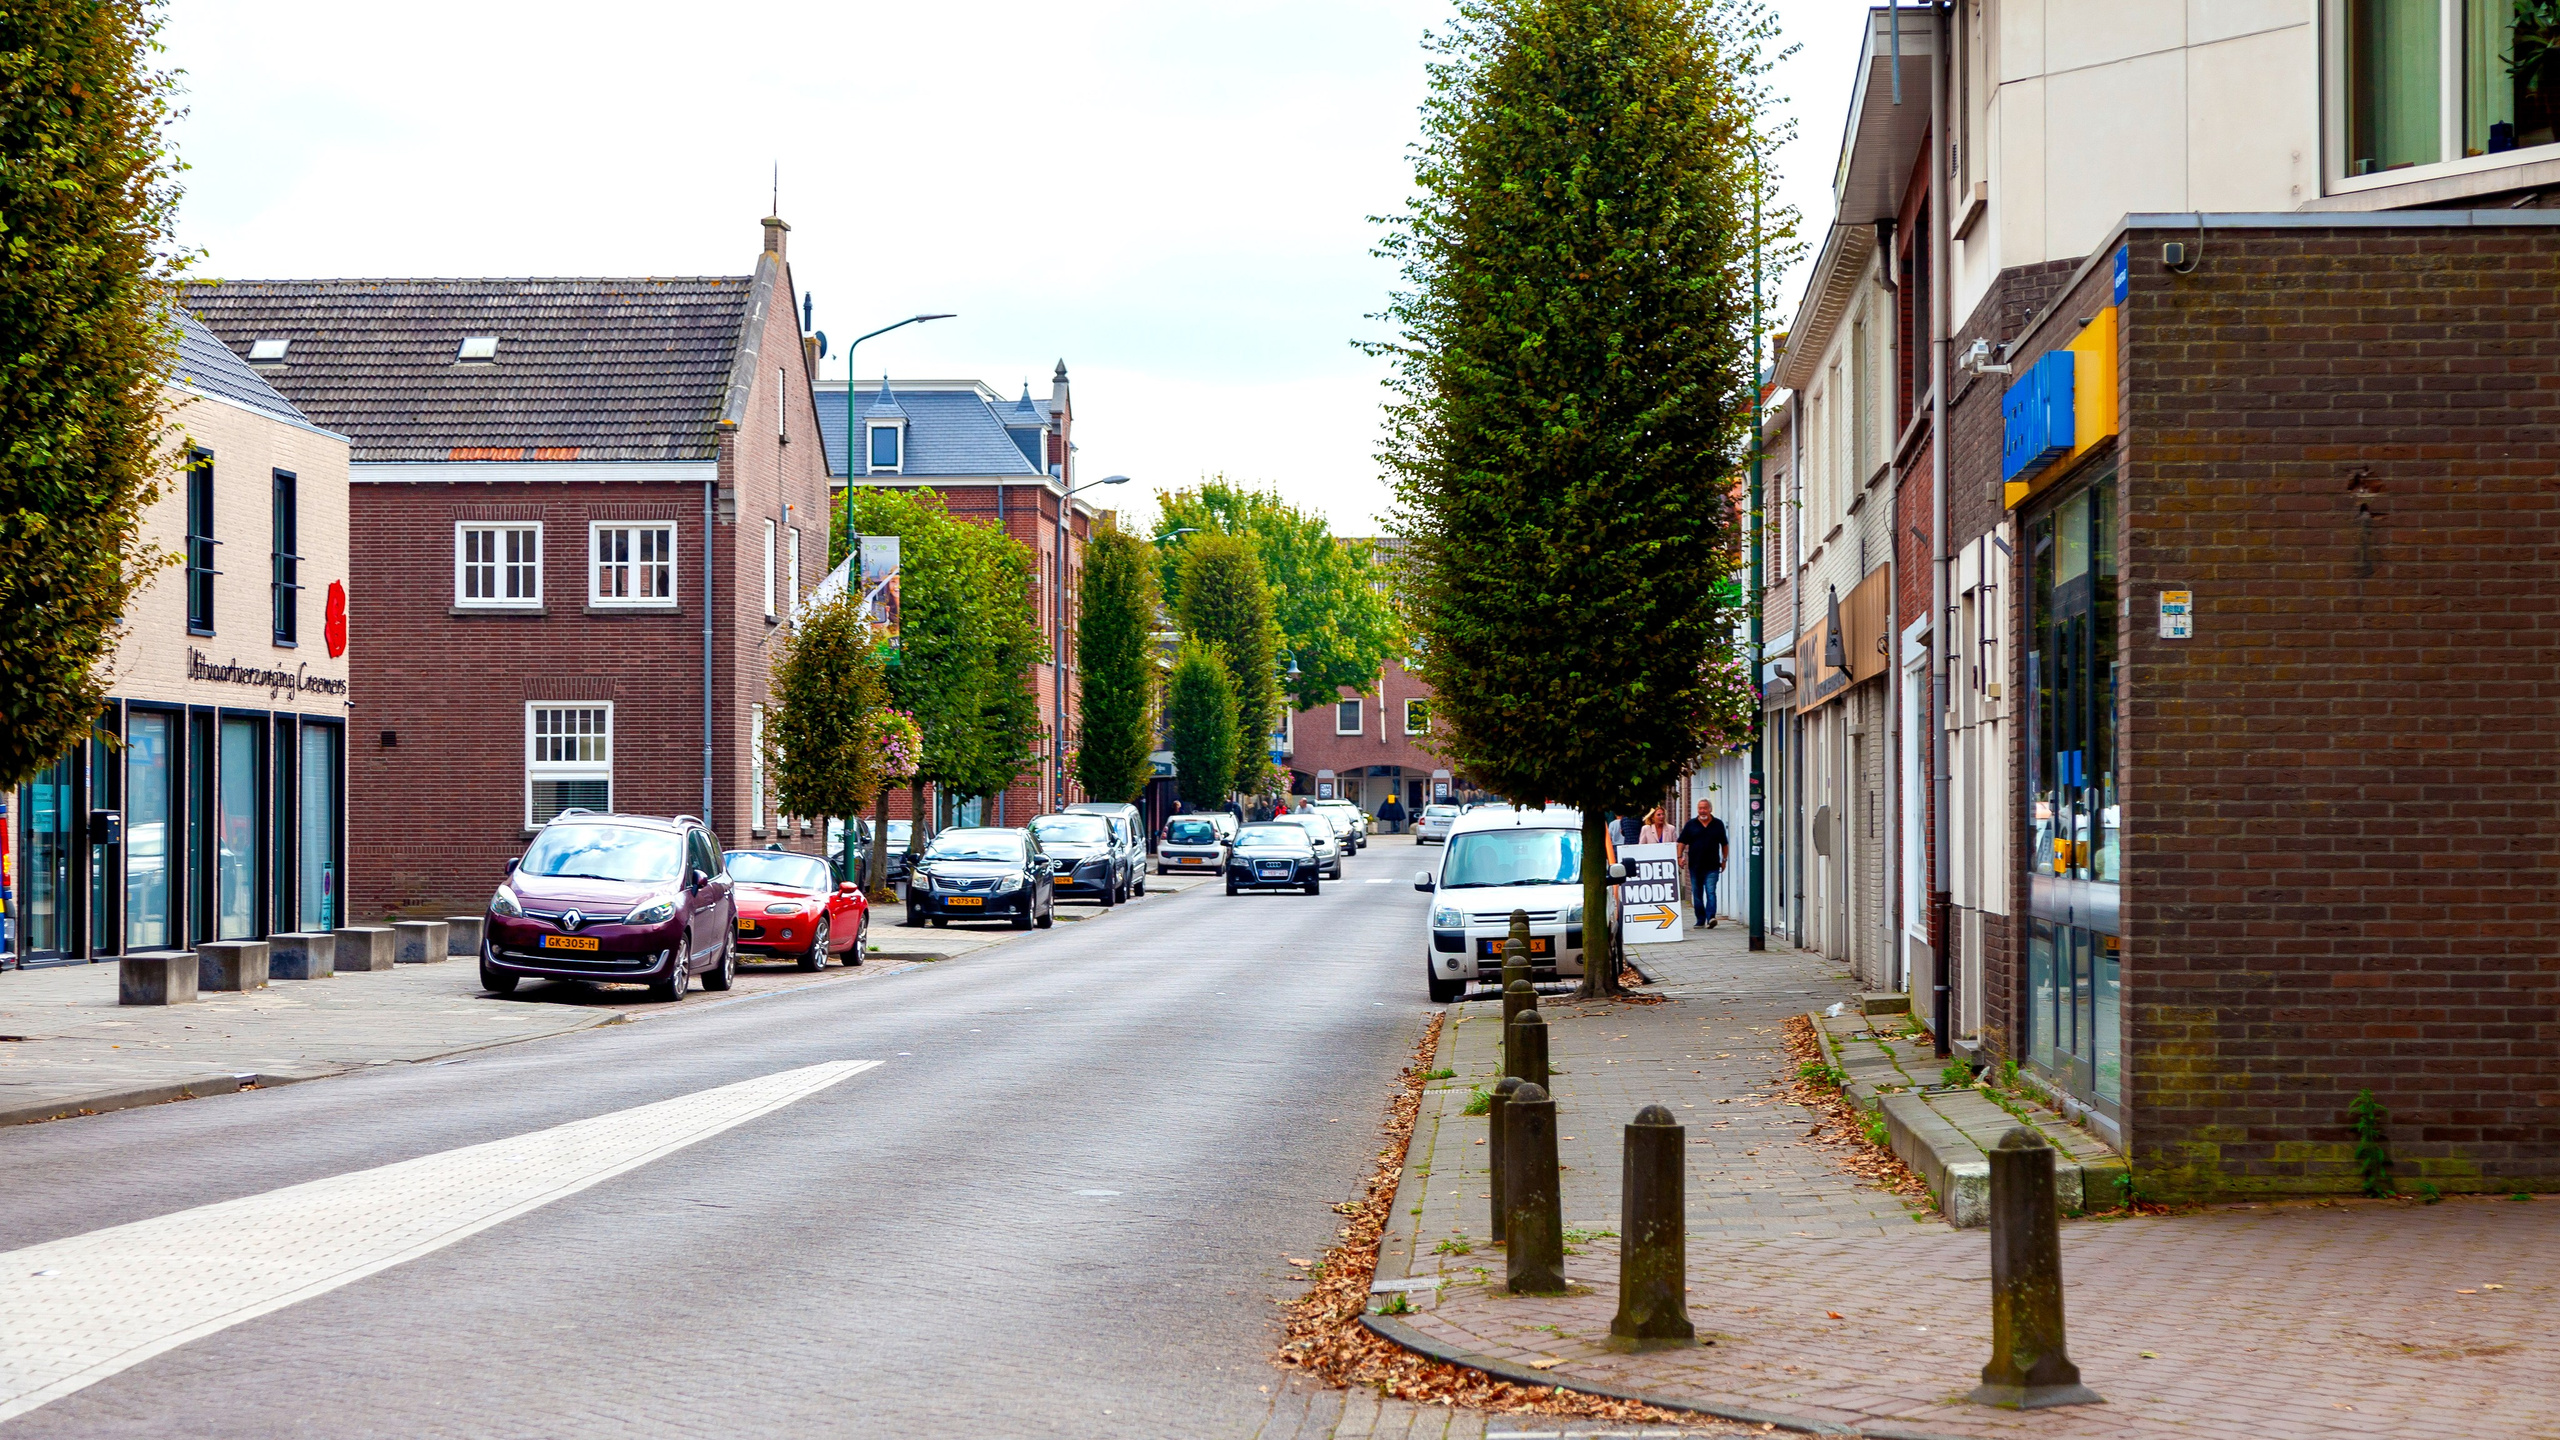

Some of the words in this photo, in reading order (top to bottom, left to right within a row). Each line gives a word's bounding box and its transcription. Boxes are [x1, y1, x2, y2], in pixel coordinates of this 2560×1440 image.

[187, 645, 296, 700] Uitvaartverzorging
[297, 662, 347, 695] Creemers
[1625, 883, 1675, 903] MODE
[548, 937, 596, 949] GK-305-H
